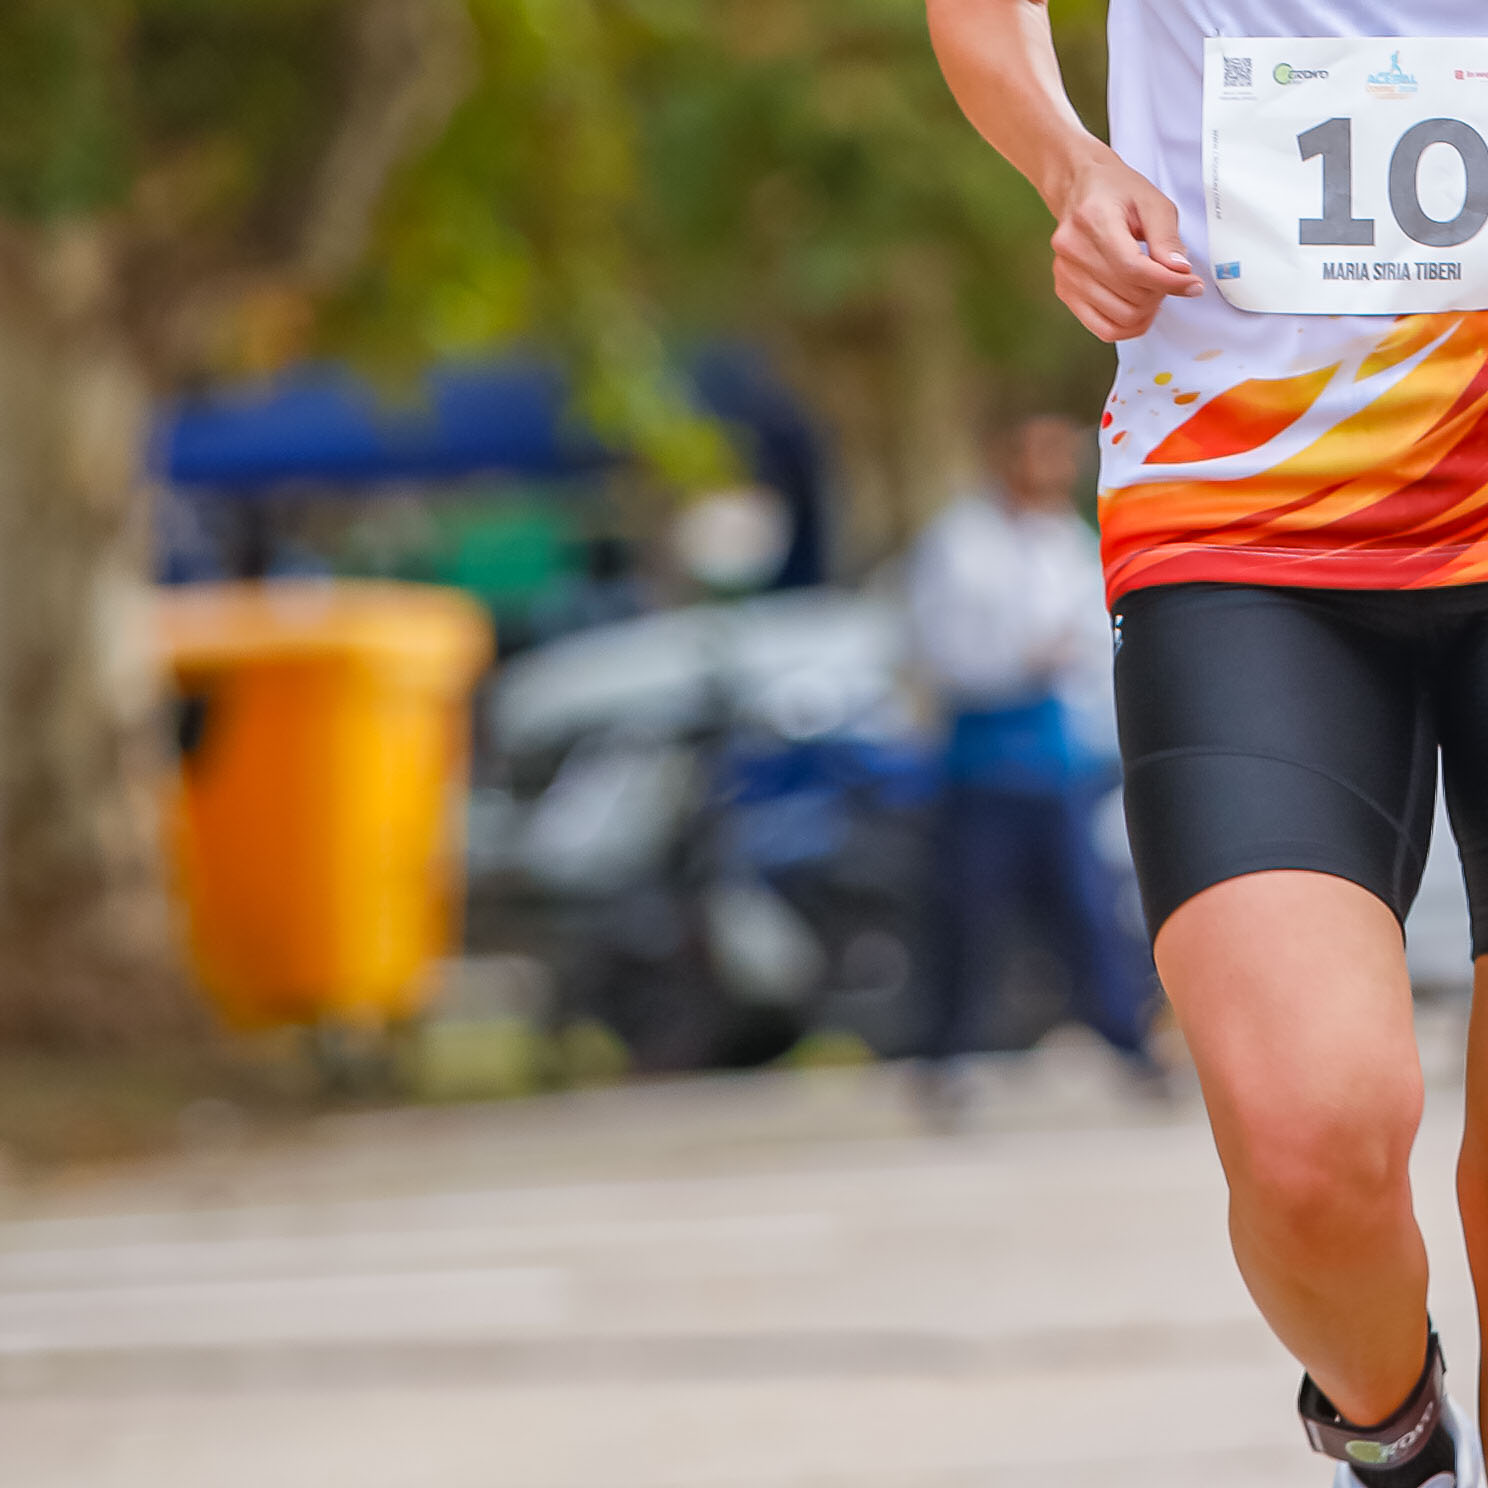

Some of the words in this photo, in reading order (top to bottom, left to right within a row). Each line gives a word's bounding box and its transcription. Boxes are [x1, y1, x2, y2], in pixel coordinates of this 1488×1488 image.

[1322, 262, 1370, 281] MARIA
[1372, 262, 1411, 281] SIRIA
[1414, 262, 1462, 281] TIBERI
